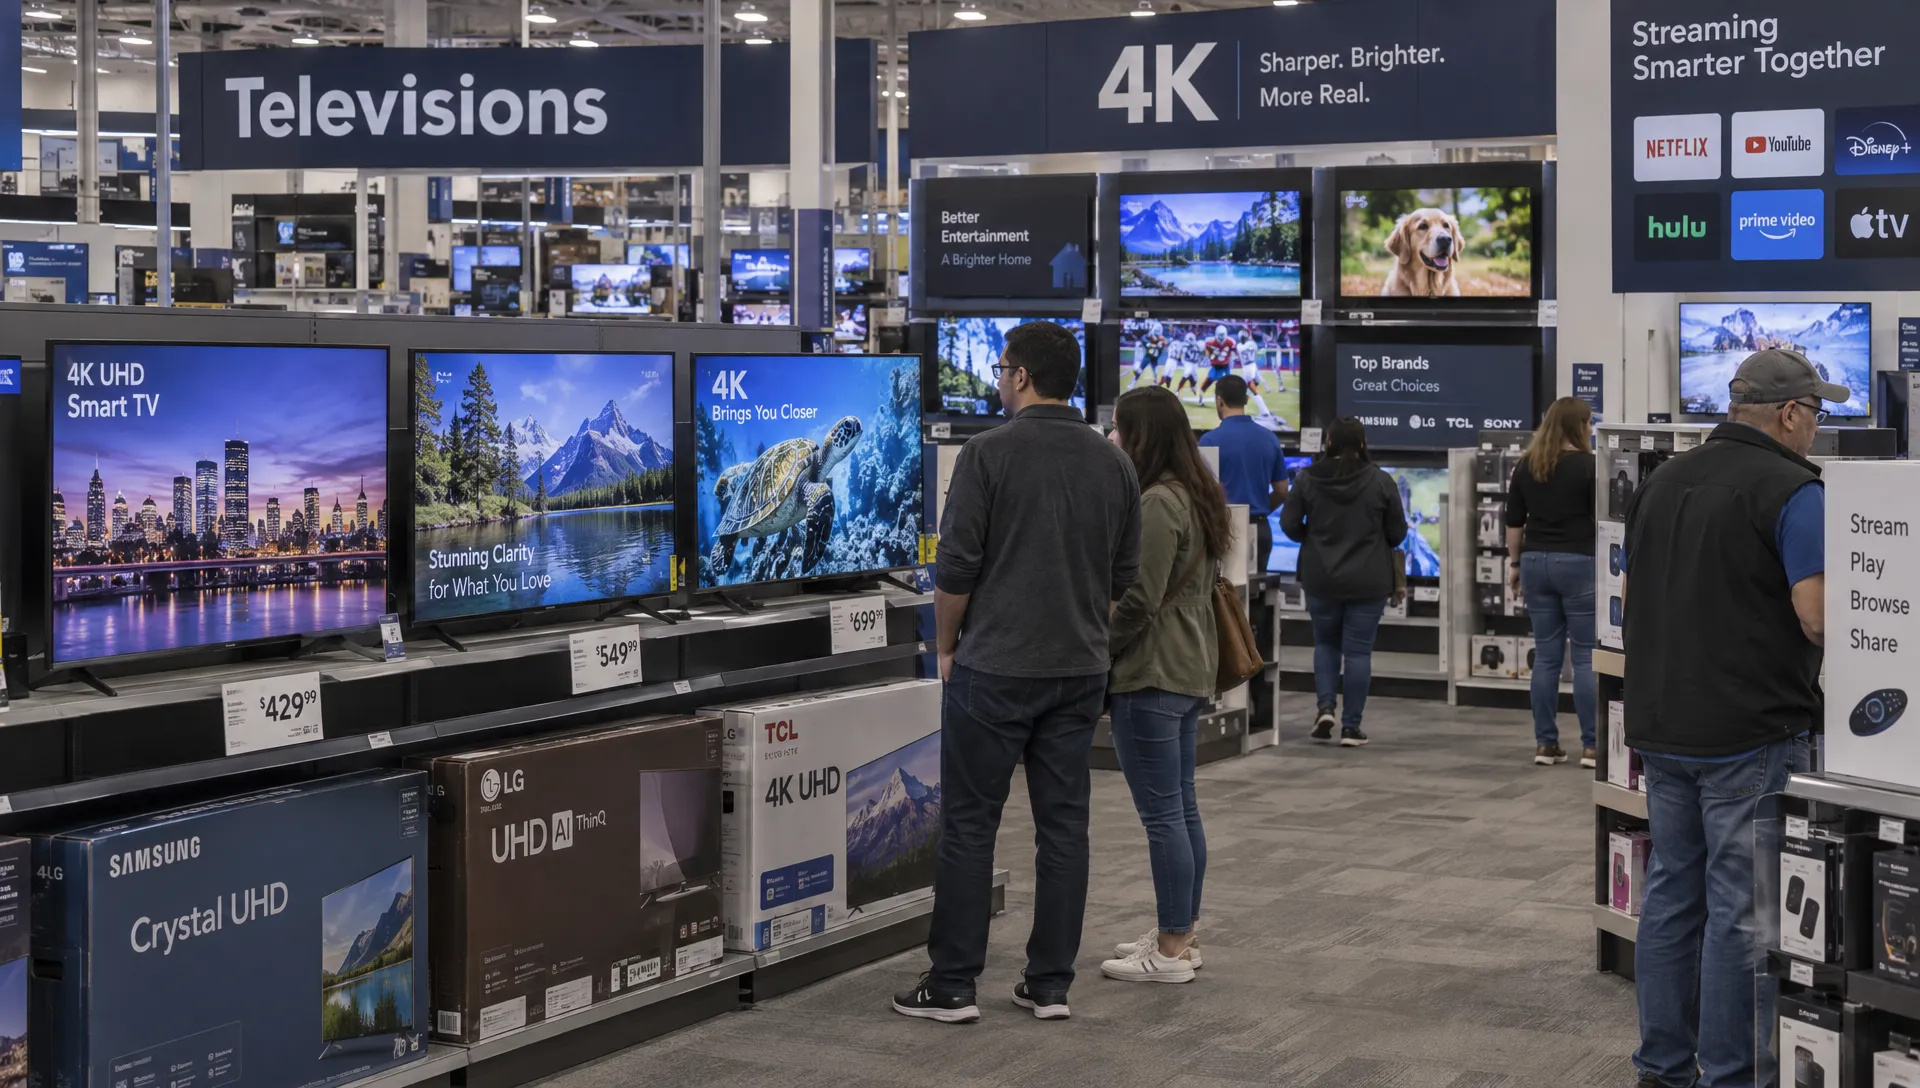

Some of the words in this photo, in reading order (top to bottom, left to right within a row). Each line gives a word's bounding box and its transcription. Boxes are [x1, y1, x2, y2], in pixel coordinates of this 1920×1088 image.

[1632, 13, 1778, 45] Streaming
[1259, 51, 1344, 76] Sharper.
[1351, 44, 1446, 73] Brighter.
[1633, 53, 1745, 80] Smarter
[1754, 41, 1886, 78] Together
[1098, 41, 1220, 124] 4K
[1259, 86, 1313, 107] More
[1320, 81, 1370, 105] Real.
[225, 73, 608, 138] Televisions
[1646, 137, 1708, 159] NETFLIX
[1768, 134, 1811, 153] YouTube
[941, 211, 980, 224] Better
[1648, 215, 1706, 238] hulu
[1739, 213, 1777, 231] prime
[1780, 211, 1816, 228] video
[941, 229, 1029, 244] Entertainment
[941, 253, 951, 266] A
[952, 253, 996, 268] Brighter
[998, 253, 1032, 266] Home
[67, 363, 94, 386] 4K
[100, 362, 144, 385] UHD
[1352, 355, 1378, 372] Top
[1382, 355, 1429, 371] Brands
[712, 370, 748, 400] 4K
[1352, 378, 1387, 391] Great
[1390, 378, 1440, 392] Choices
[67, 393, 128, 418] Smart
[132, 393, 160, 416] TV
[712, 405, 752, 423] Brings
[754, 405, 777, 420] You
[781, 403, 818, 419] Closer
[1422, 418, 1435, 427] LG
[1446, 418, 1473, 428] TCL
[1484, 419, 1522, 428] SONY
[1850, 513, 1908, 537] Stream
[428, 547, 489, 570] Stunning
[493, 543, 535, 566] Clarity
[1850, 551, 1885, 580] Play
[428, 578, 449, 599] for
[452, 576, 489, 597] What
[492, 572, 517, 592] You
[521, 572, 552, 590] Love
[1850, 590, 1910, 615] Browse
[1850, 628, 1898, 653] Share
[765, 719, 798, 744] TCL
[504, 769, 524, 794] LG
[765, 775, 794, 808] 4K
[799, 766, 840, 800] UHD
[491, 818, 547, 863] UHD
[554, 817, 571, 843] AI
[576, 809, 607, 831] ThinQ
[109, 836, 201, 878] SAMSUNG
[130, 895, 223, 955] Crystal
[231, 881, 289, 925] UHD
